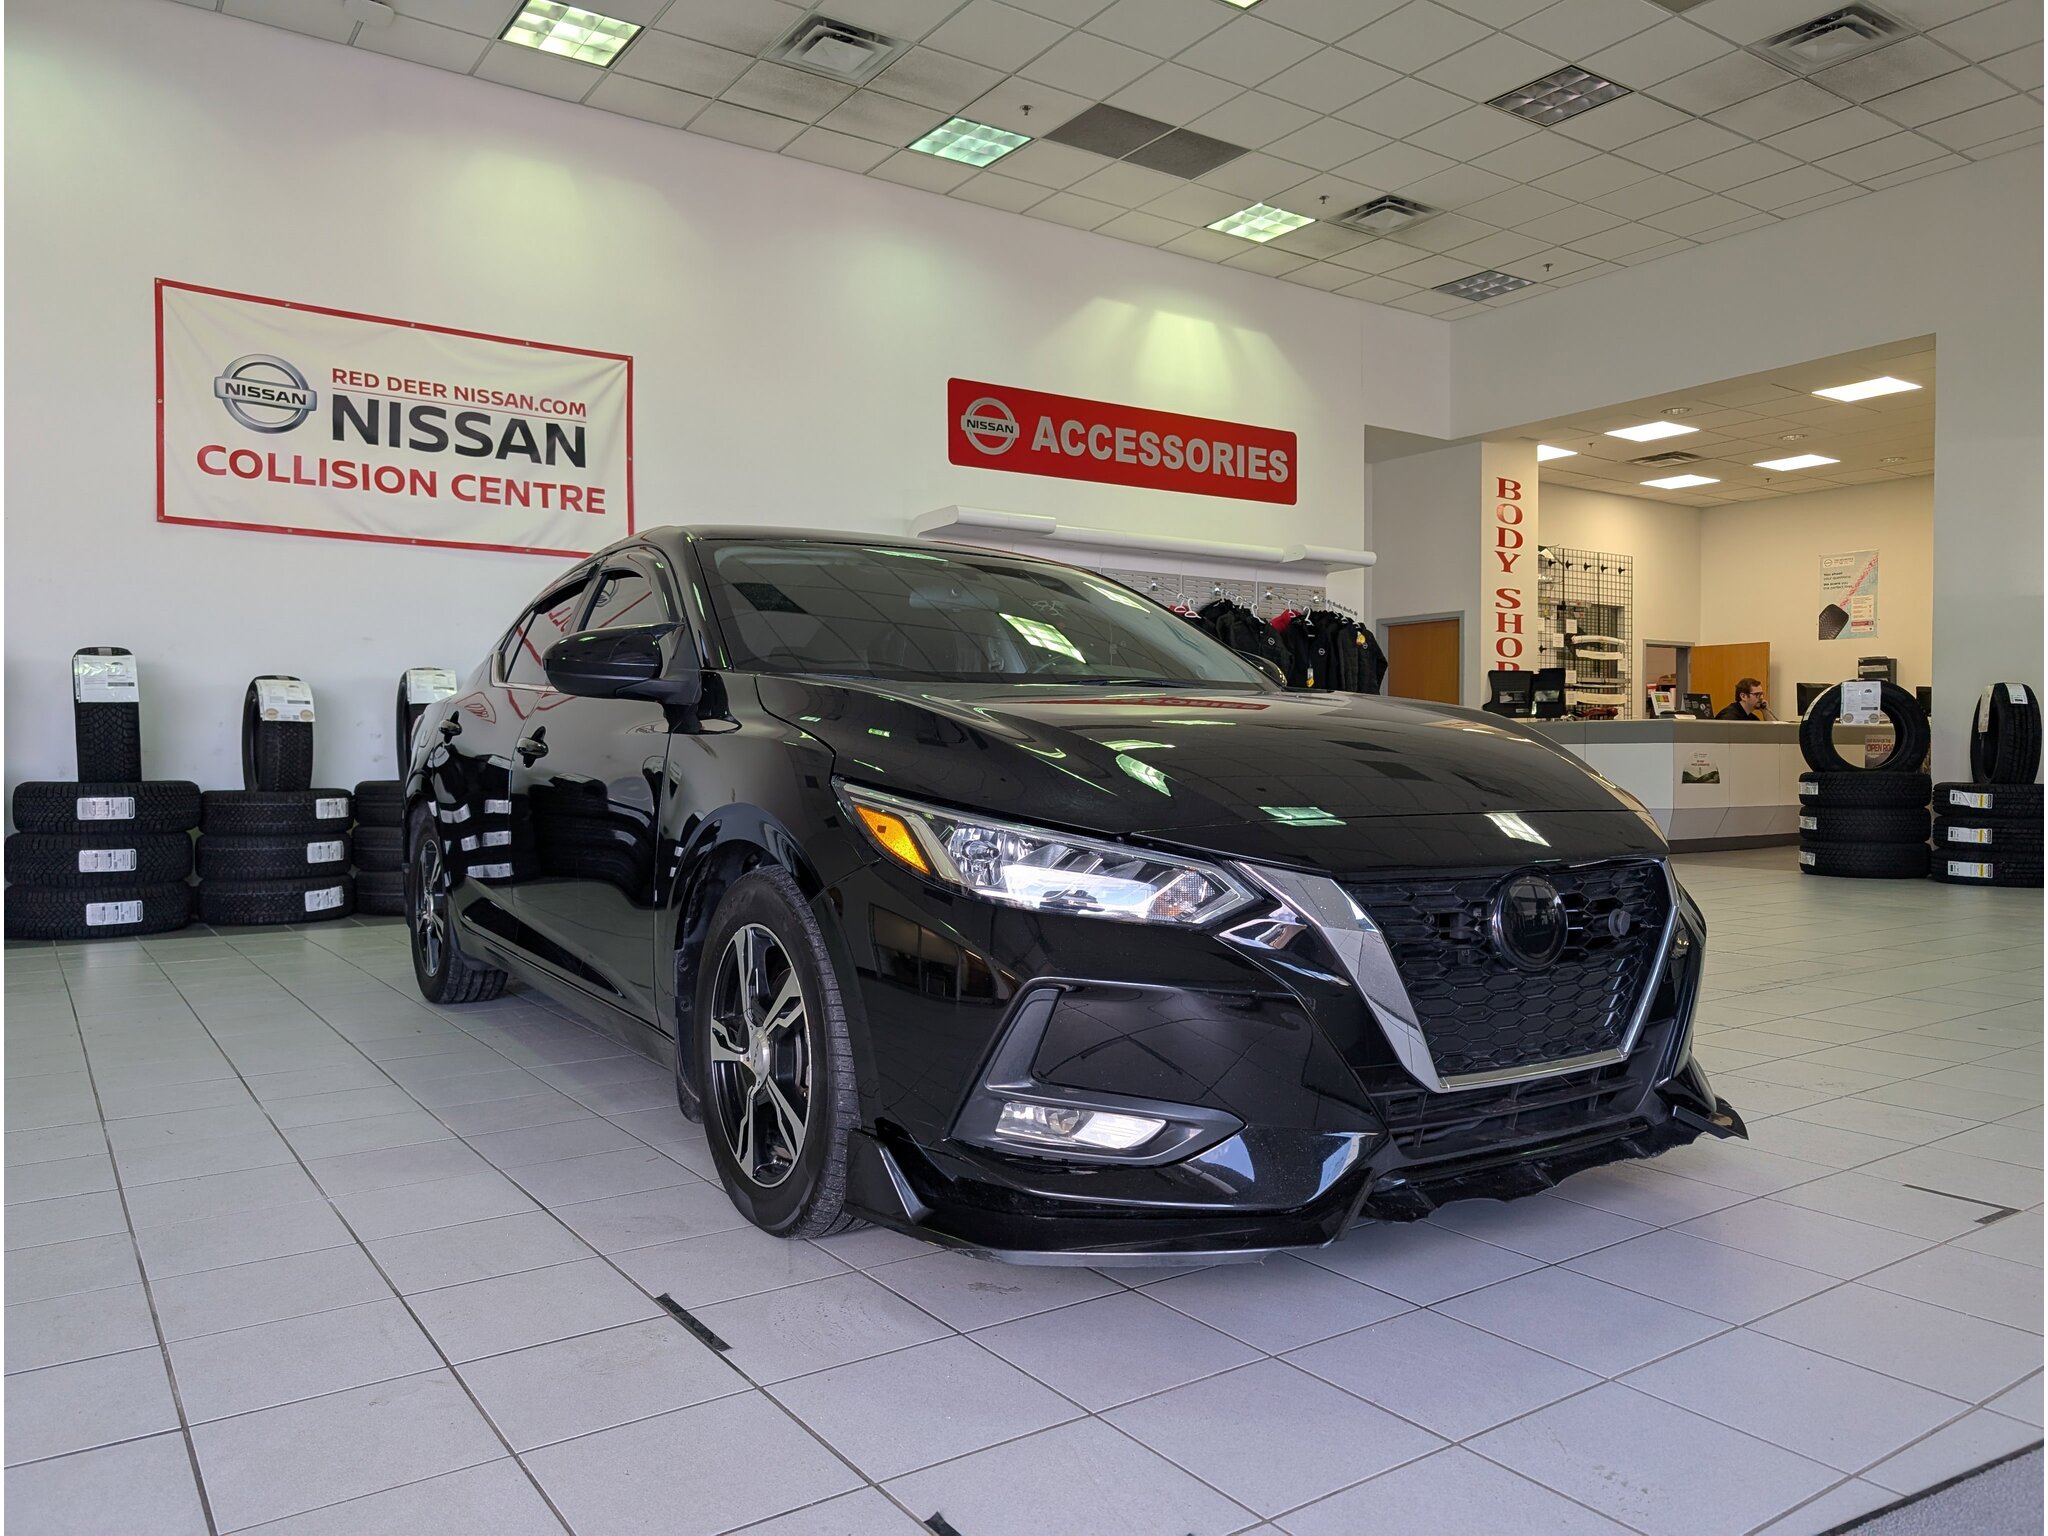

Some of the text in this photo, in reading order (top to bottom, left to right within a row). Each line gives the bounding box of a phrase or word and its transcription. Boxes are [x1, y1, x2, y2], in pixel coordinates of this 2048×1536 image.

[225, 382, 307, 406] NISSAN
[332, 367, 587, 418] RED DEER NISSAN.COM
[966, 418, 1014, 434] NISSAN
[331, 394, 587, 468] NISSAN
[1031, 415, 1289, 483] ACCESSORIES
[196, 445, 607, 515] COLLISION CENTRE
[1494, 476, 1524, 574] BODY
